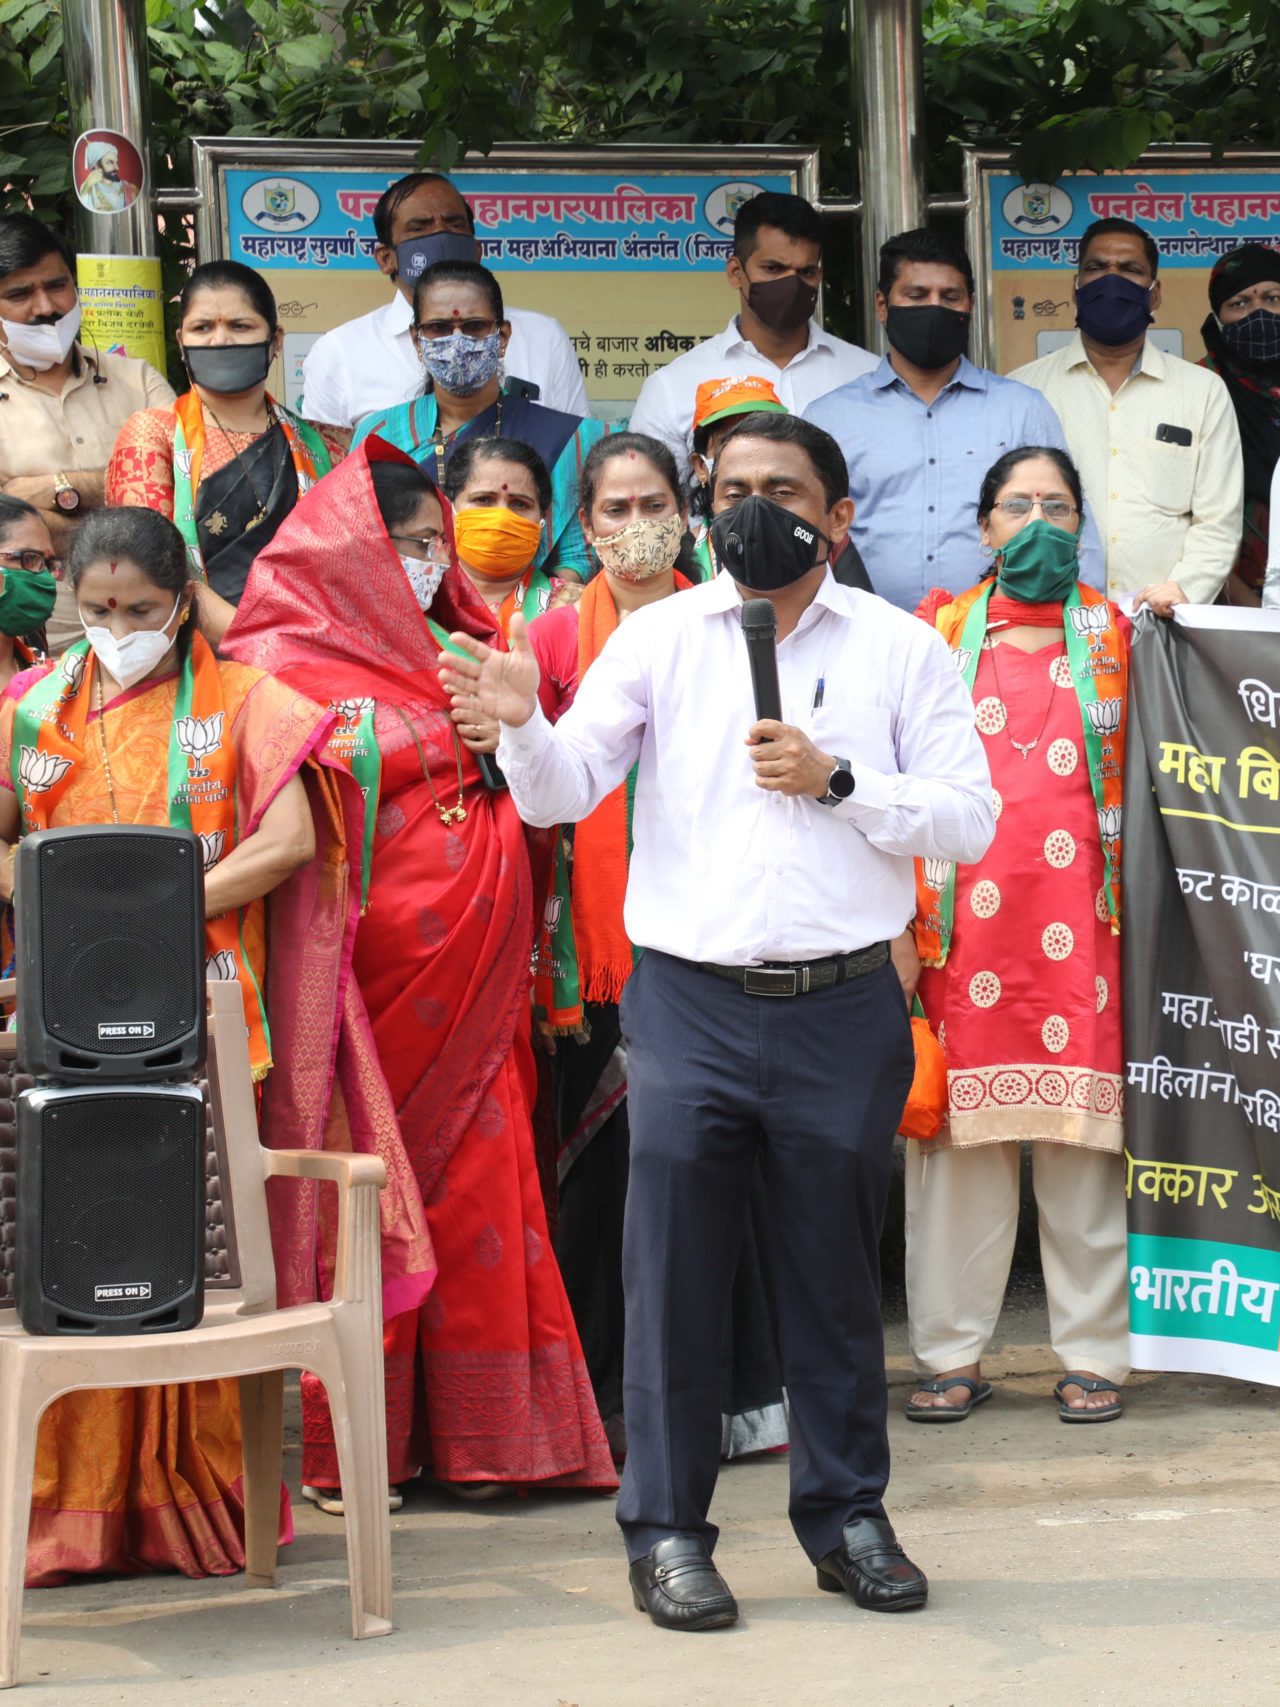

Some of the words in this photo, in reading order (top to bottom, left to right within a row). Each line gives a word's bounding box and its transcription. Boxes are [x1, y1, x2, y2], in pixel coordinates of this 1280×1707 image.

[1089, 184, 1184, 221] पनवेल
[241, 236, 306, 262] महाराष्ट्र
[309, 230, 355, 265] सुवर्ण
[622, 232, 680, 260] अंतर्गत
[1002, 237, 1060, 262] महाराष्ट्र
[596, 336, 639, 352] बाजार
[645, 330, 696, 352] अधिक
[613, 358, 650, 378] करतो
[1159, 742, 1225, 794] महा
[100, 1027, 127, 1036] PRESS
[128, 1026, 142, 1034] ON
[1127, 1055, 1240, 1105] महिलांना
[96, 1288, 123, 1298] PRESS
[125, 1287, 139, 1296] ON
[1130, 1259, 1280, 1323] भारतीय
